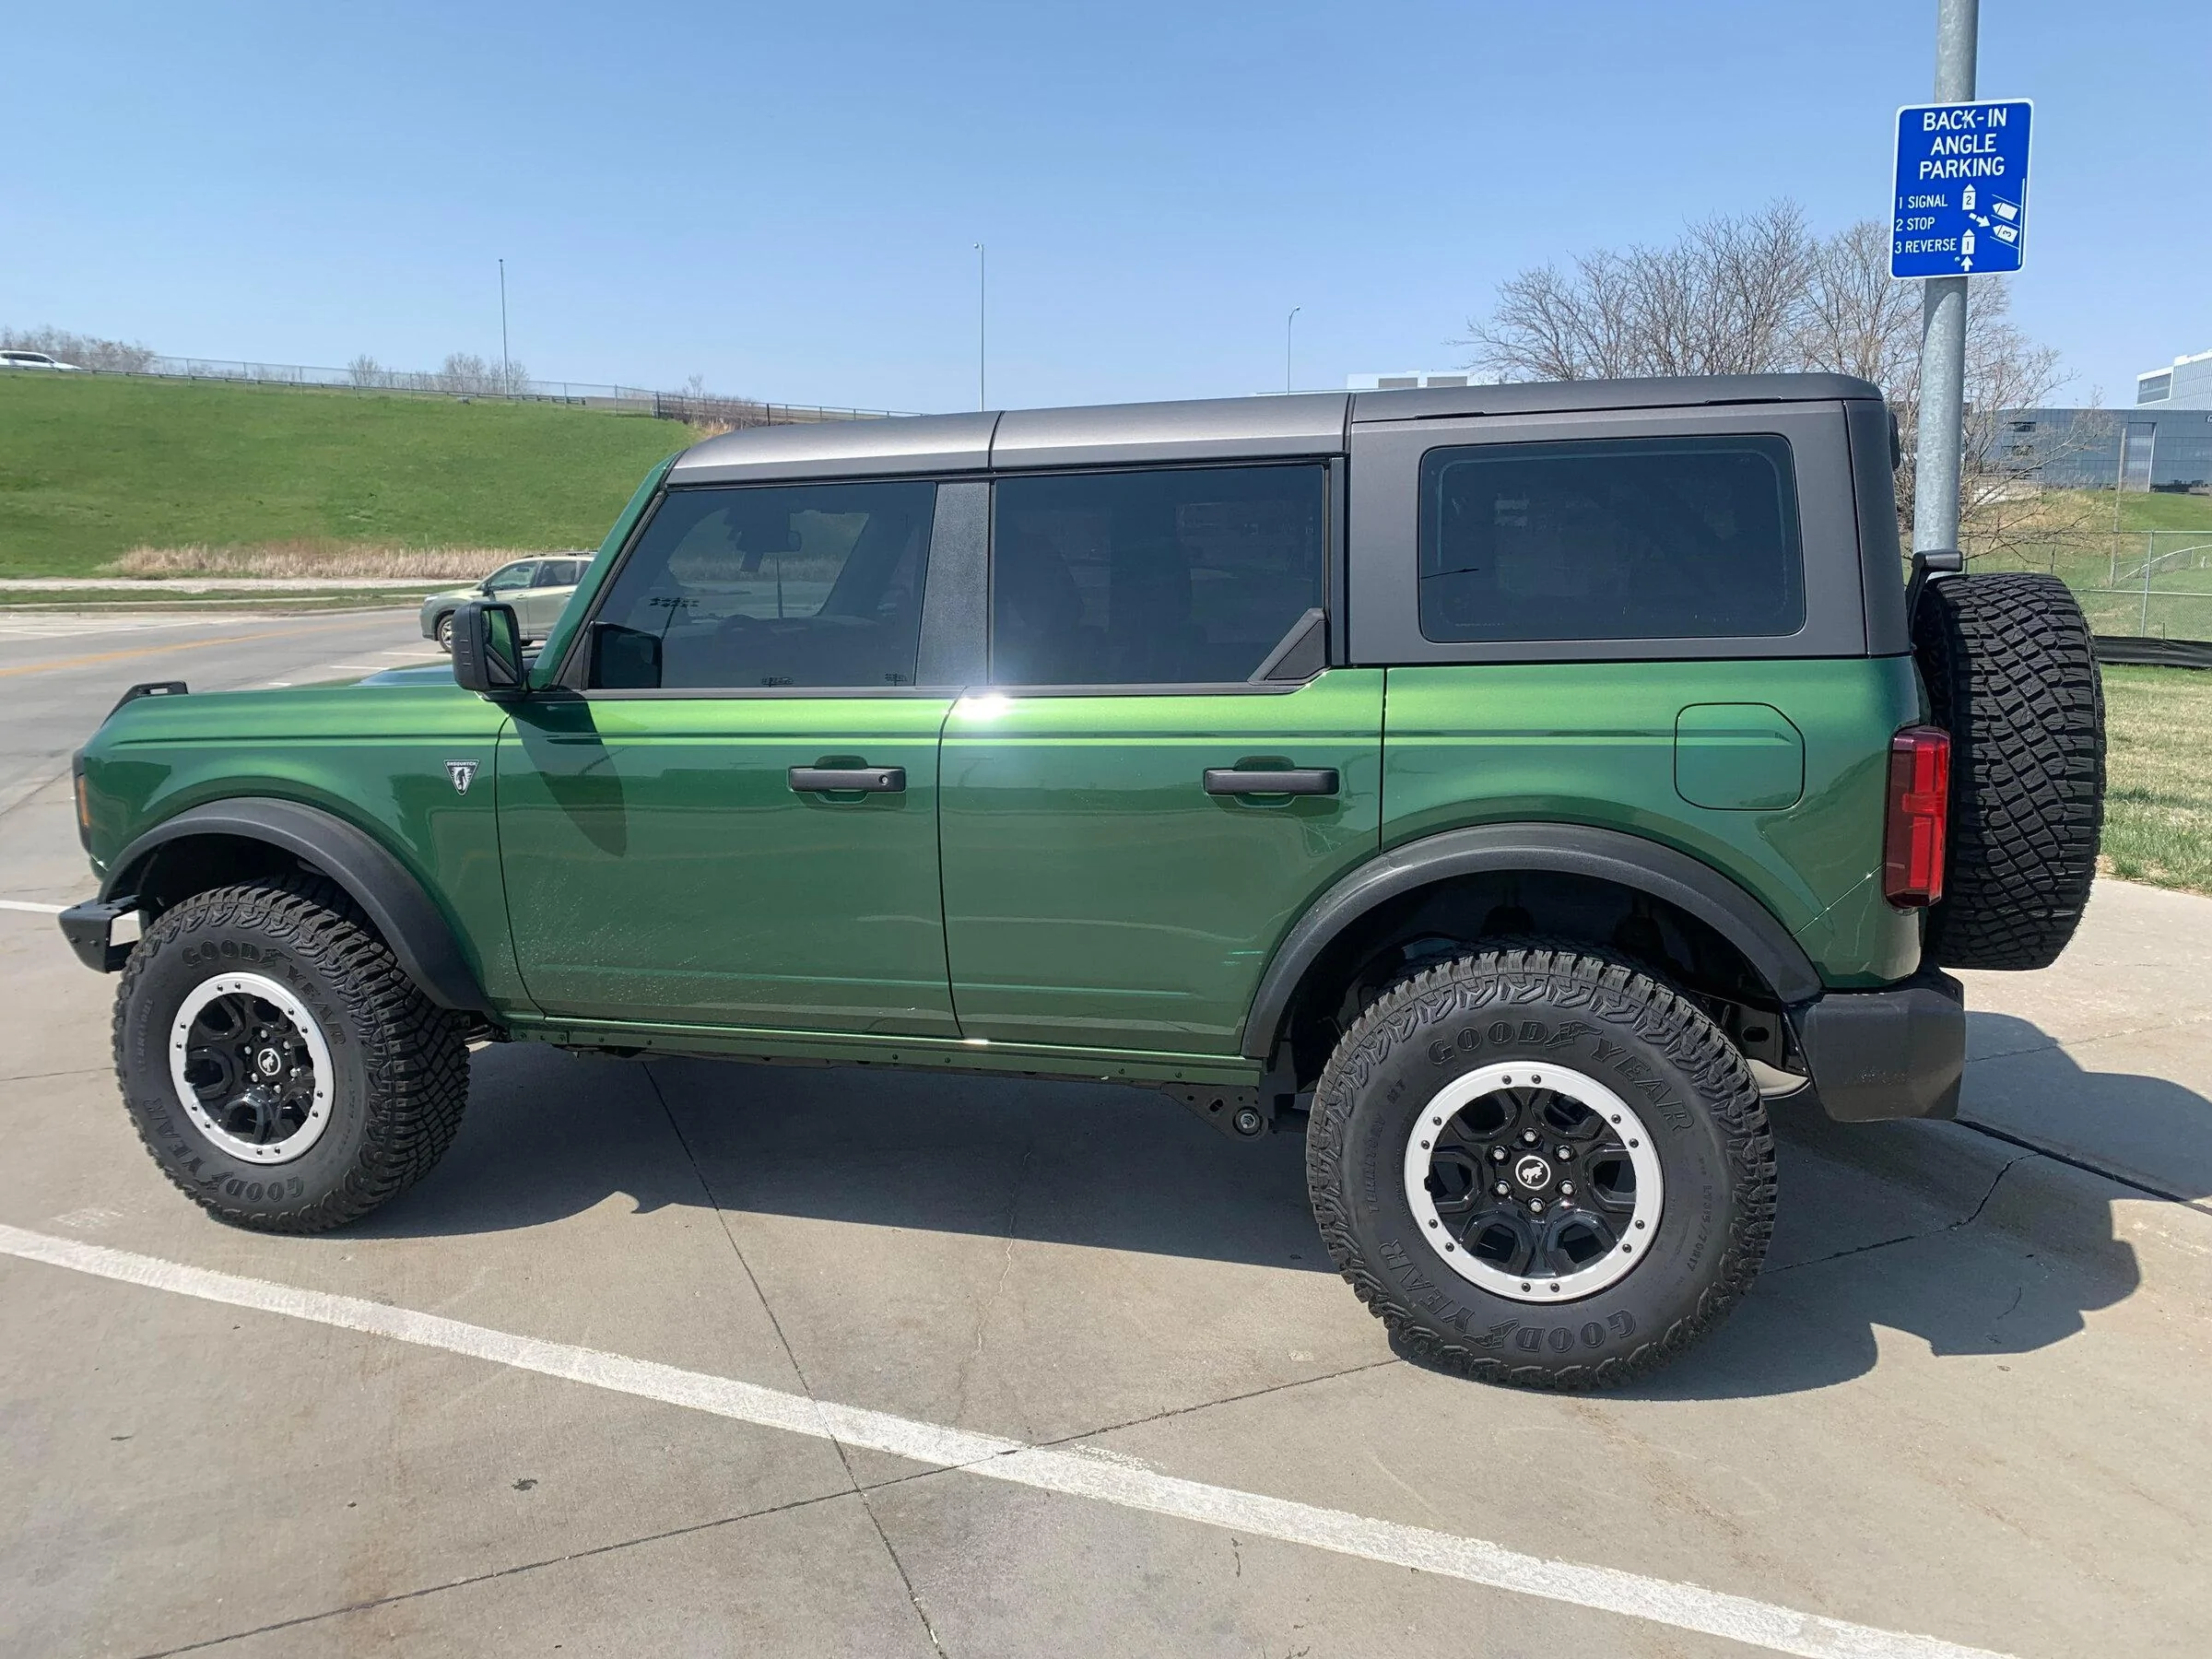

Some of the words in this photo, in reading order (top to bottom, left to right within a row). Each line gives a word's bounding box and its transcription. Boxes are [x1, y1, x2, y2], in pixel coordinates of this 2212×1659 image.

[1923, 108, 2007, 131] BACK-IN
[1930, 133, 1997, 156] ANGLE
[1919, 156, 2005, 180] PARKING
[1899, 196, 1902, 209] 1
[1907, 194, 1948, 209] SIGNAL
[1966, 195, 1972, 206] 2
[1895, 218, 1903, 231] 2
[1906, 217, 1936, 230] STOP
[1895, 241, 1902, 254] 3
[1905, 238, 1958, 253] REVERSE
